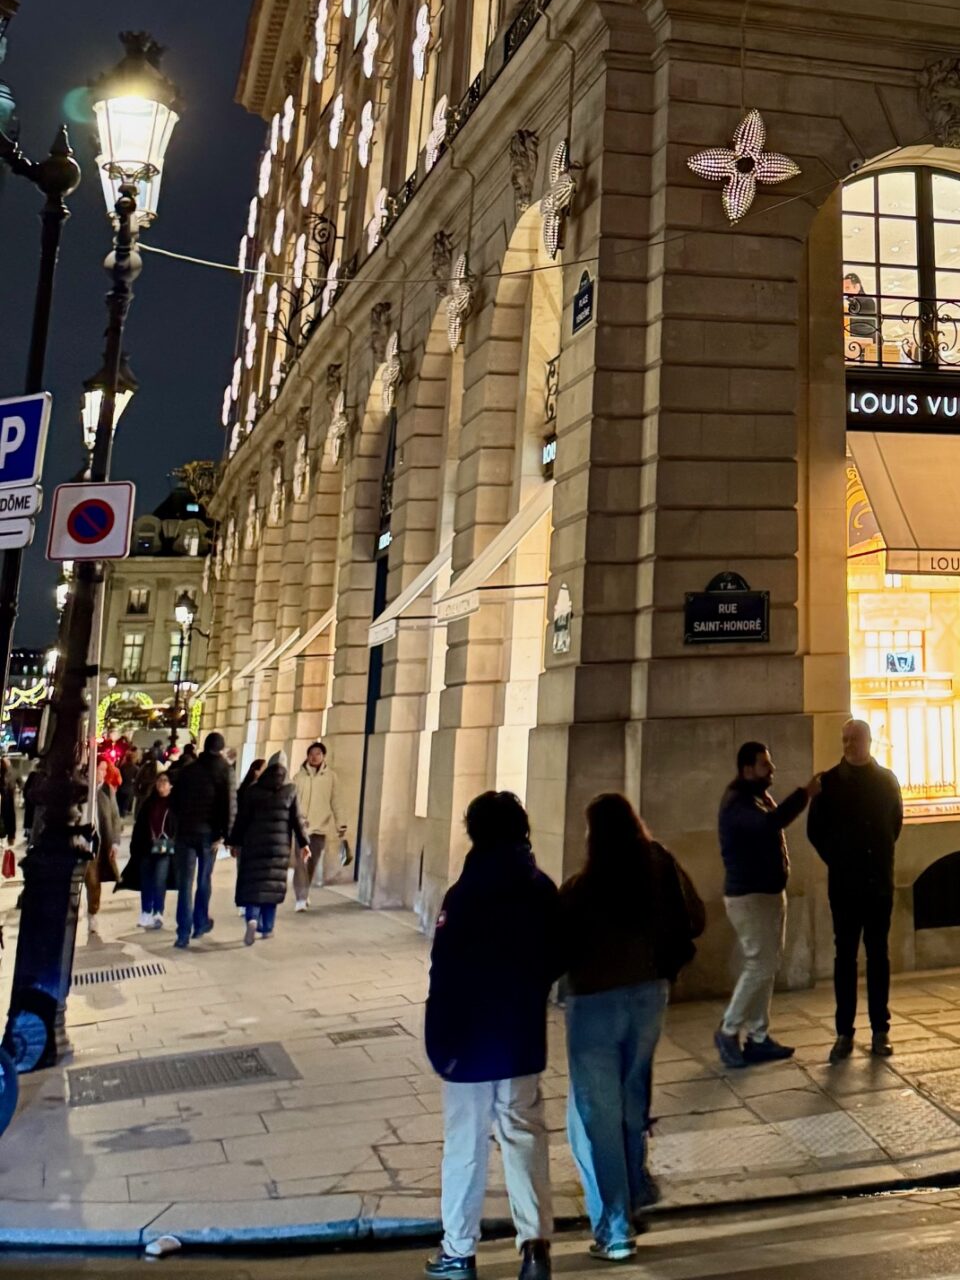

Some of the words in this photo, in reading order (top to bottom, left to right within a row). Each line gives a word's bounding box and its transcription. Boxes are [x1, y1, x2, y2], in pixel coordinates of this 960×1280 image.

[850, 392, 919, 415] LOUIS
[0, 415, 26, 470] P
[718, 603, 738, 614] RUE
[693, 618, 762, 632] SAINT-HONORÉ
